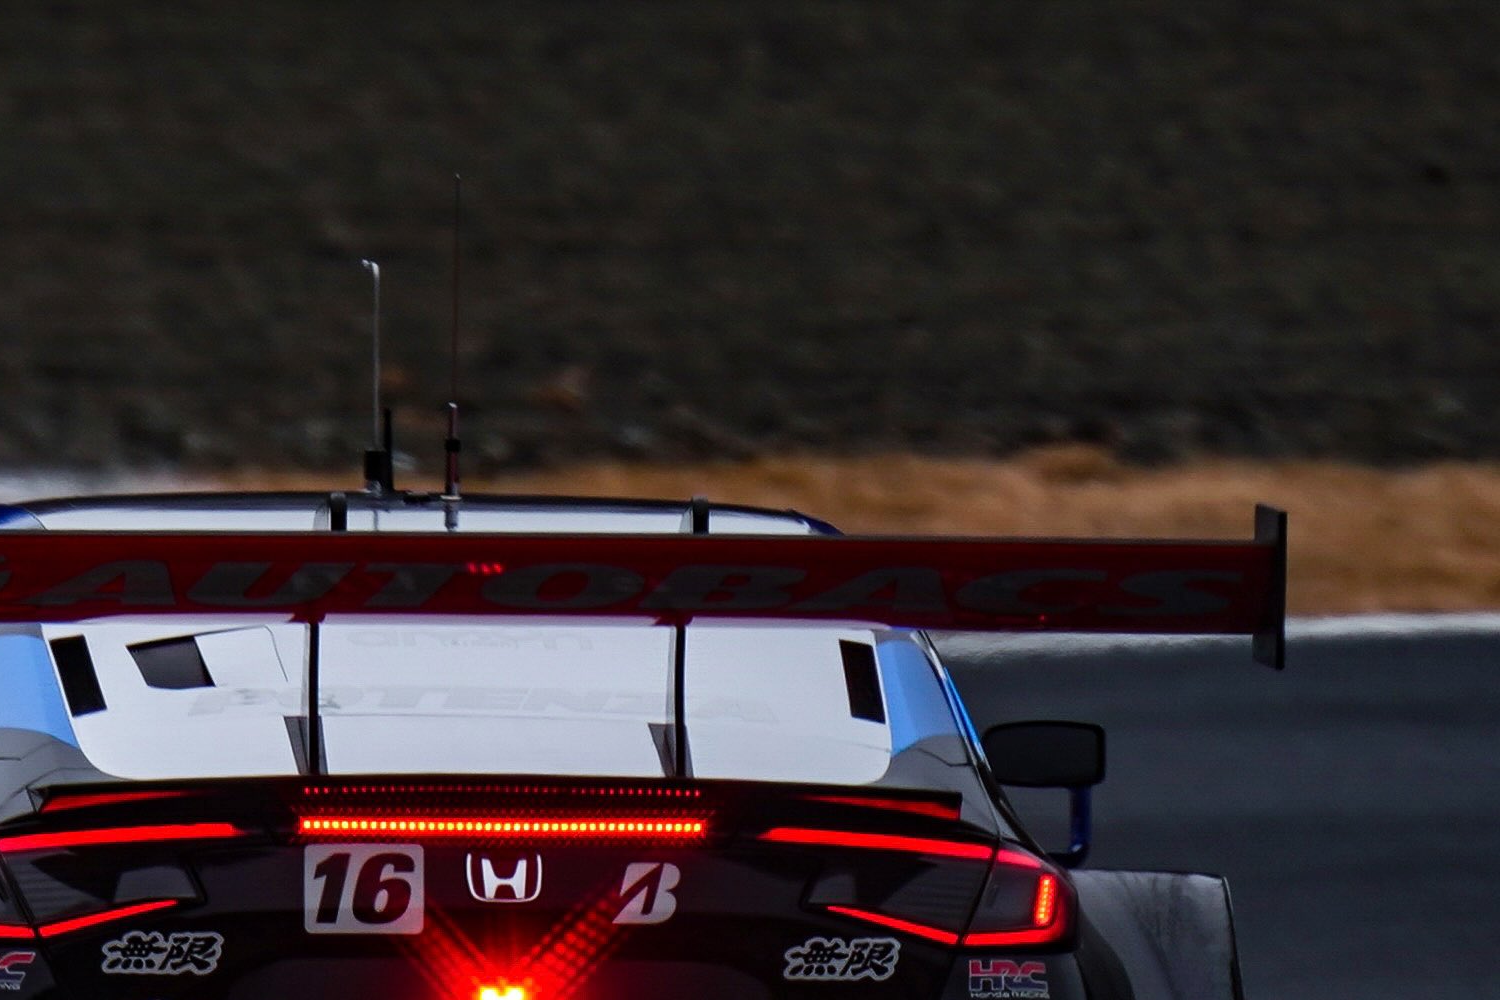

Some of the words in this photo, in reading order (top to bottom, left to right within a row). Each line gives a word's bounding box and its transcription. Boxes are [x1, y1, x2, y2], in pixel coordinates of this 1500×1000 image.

[20, 558, 1244, 617] AUTOBACS
[313, 853, 416, 925] 16
[102, 931, 224, 975] 無限
[784, 937, 900, 981] 無限
[968, 959, 1049, 992] HRC
